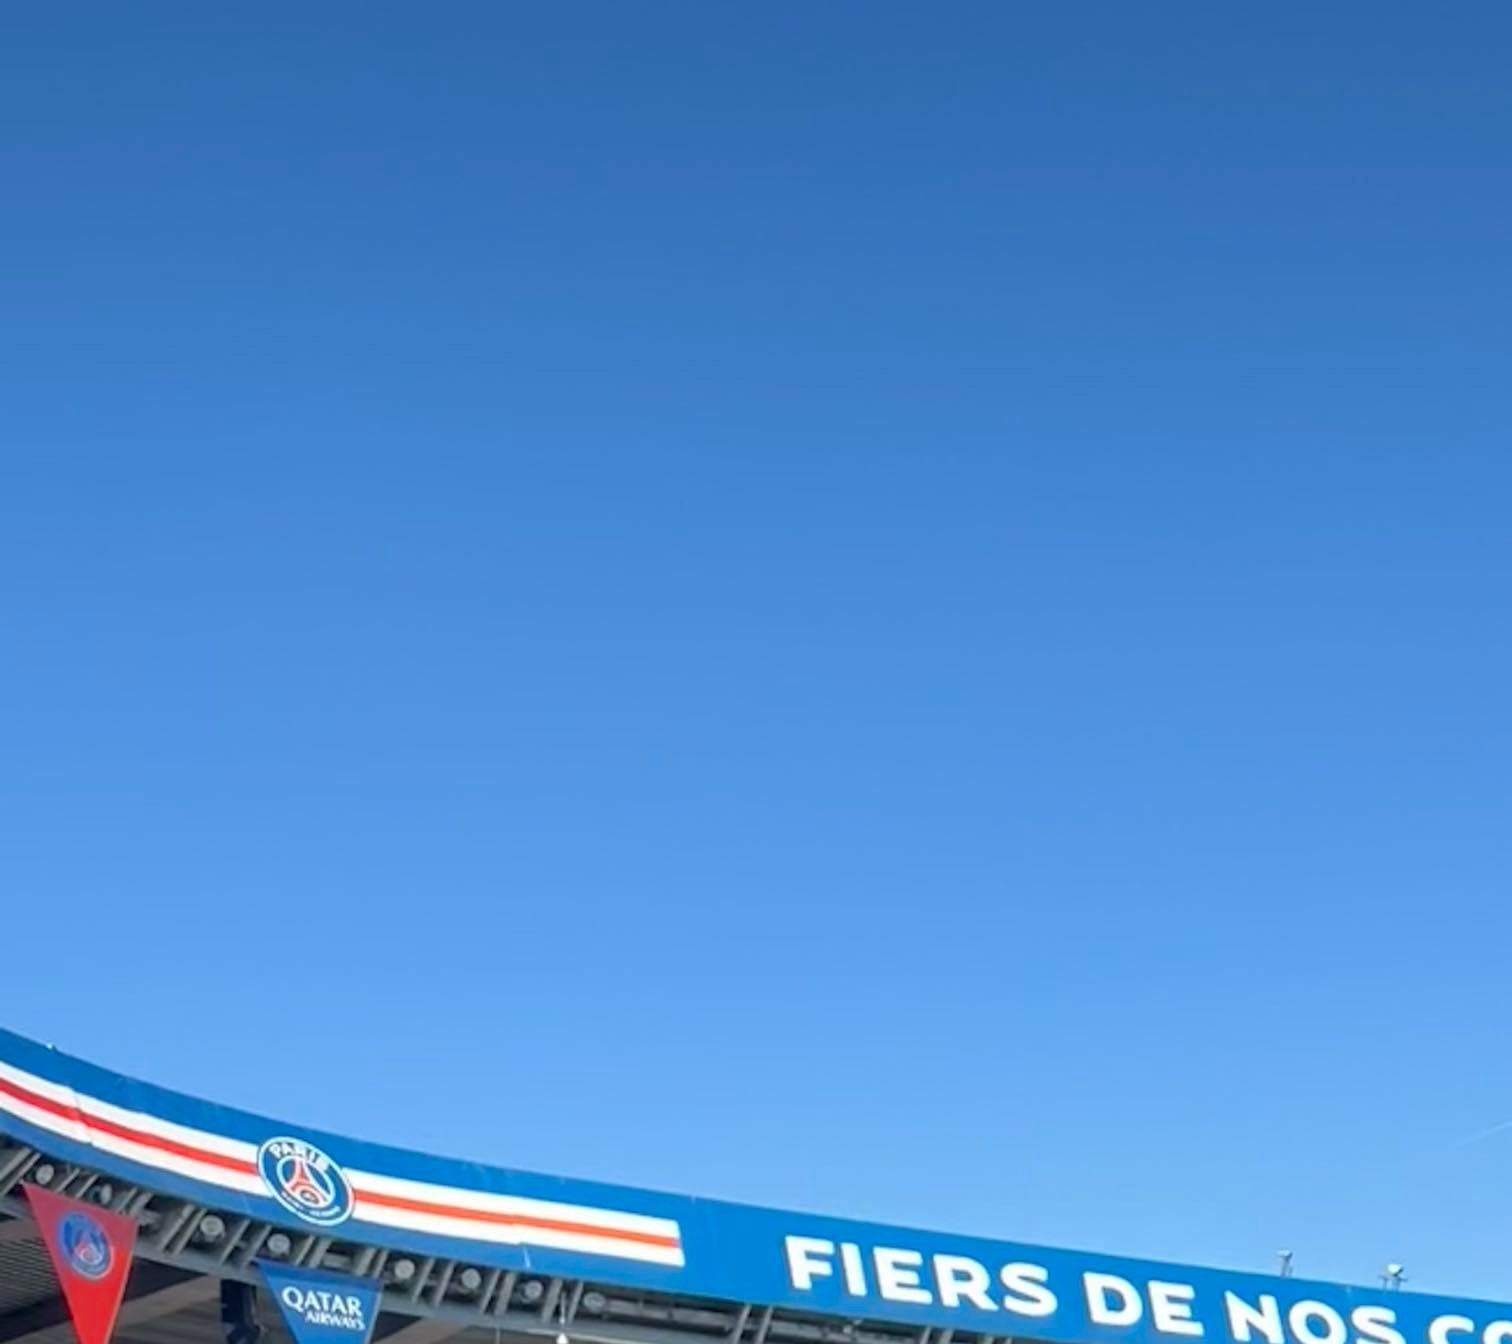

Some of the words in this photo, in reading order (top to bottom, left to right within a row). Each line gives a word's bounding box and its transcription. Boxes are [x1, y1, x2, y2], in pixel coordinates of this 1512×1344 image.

[282, 1286, 362, 1318] QATAR
[784, 1235, 1058, 1317] FIERS
[1083, 1271, 1203, 1336] DE
